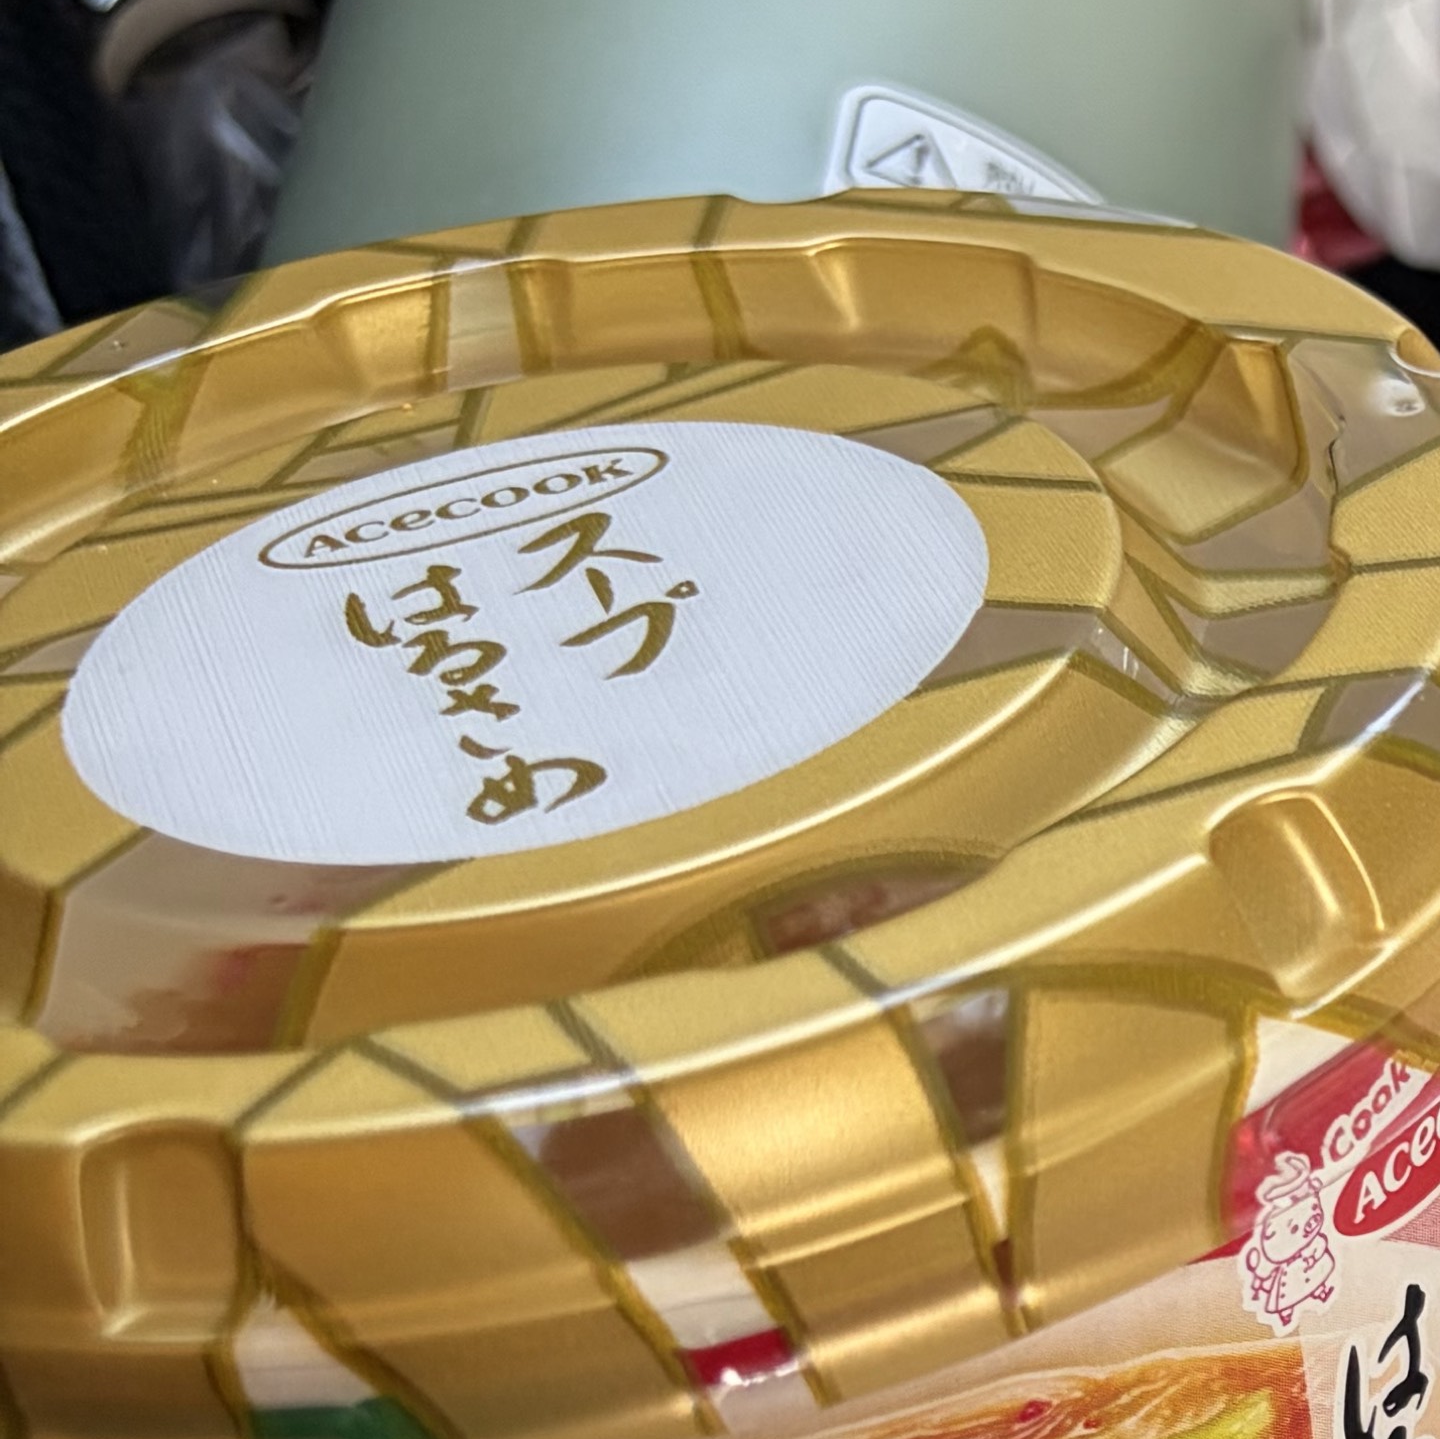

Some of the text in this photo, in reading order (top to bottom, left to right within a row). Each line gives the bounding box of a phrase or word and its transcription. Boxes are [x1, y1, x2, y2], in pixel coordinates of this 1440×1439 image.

[345, 565, 608, 824] はるさめ
[513, 512, 699, 680] スープ
